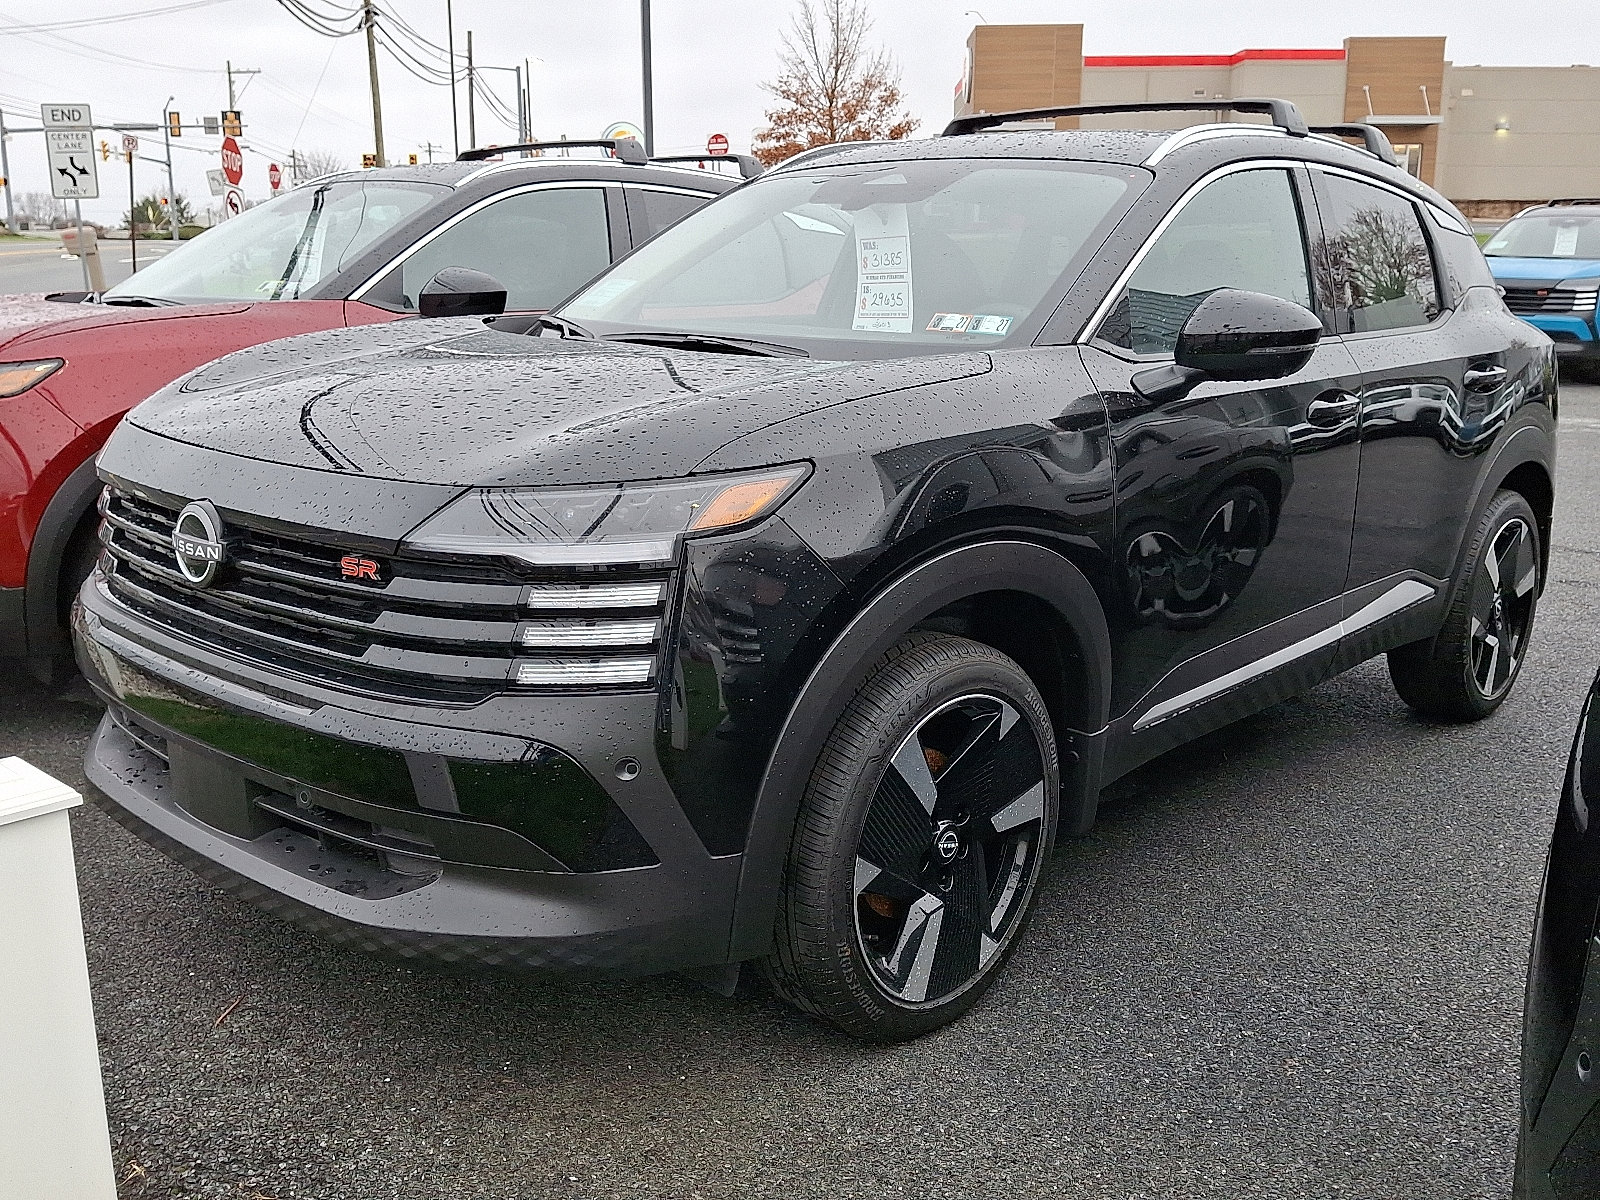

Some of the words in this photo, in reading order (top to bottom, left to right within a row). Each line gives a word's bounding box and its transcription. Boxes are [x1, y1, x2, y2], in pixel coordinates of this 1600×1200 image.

[51, 109, 82, 122] END
[51, 133, 87, 141] CENTER
[57, 142, 83, 150] LANE
[222, 148, 242, 173] STOP
[871, 251, 903, 267] 31385
[863, 285, 872, 294] IS:
[172, 536, 220, 560] NISSAN
[341, 556, 380, 580] SR
